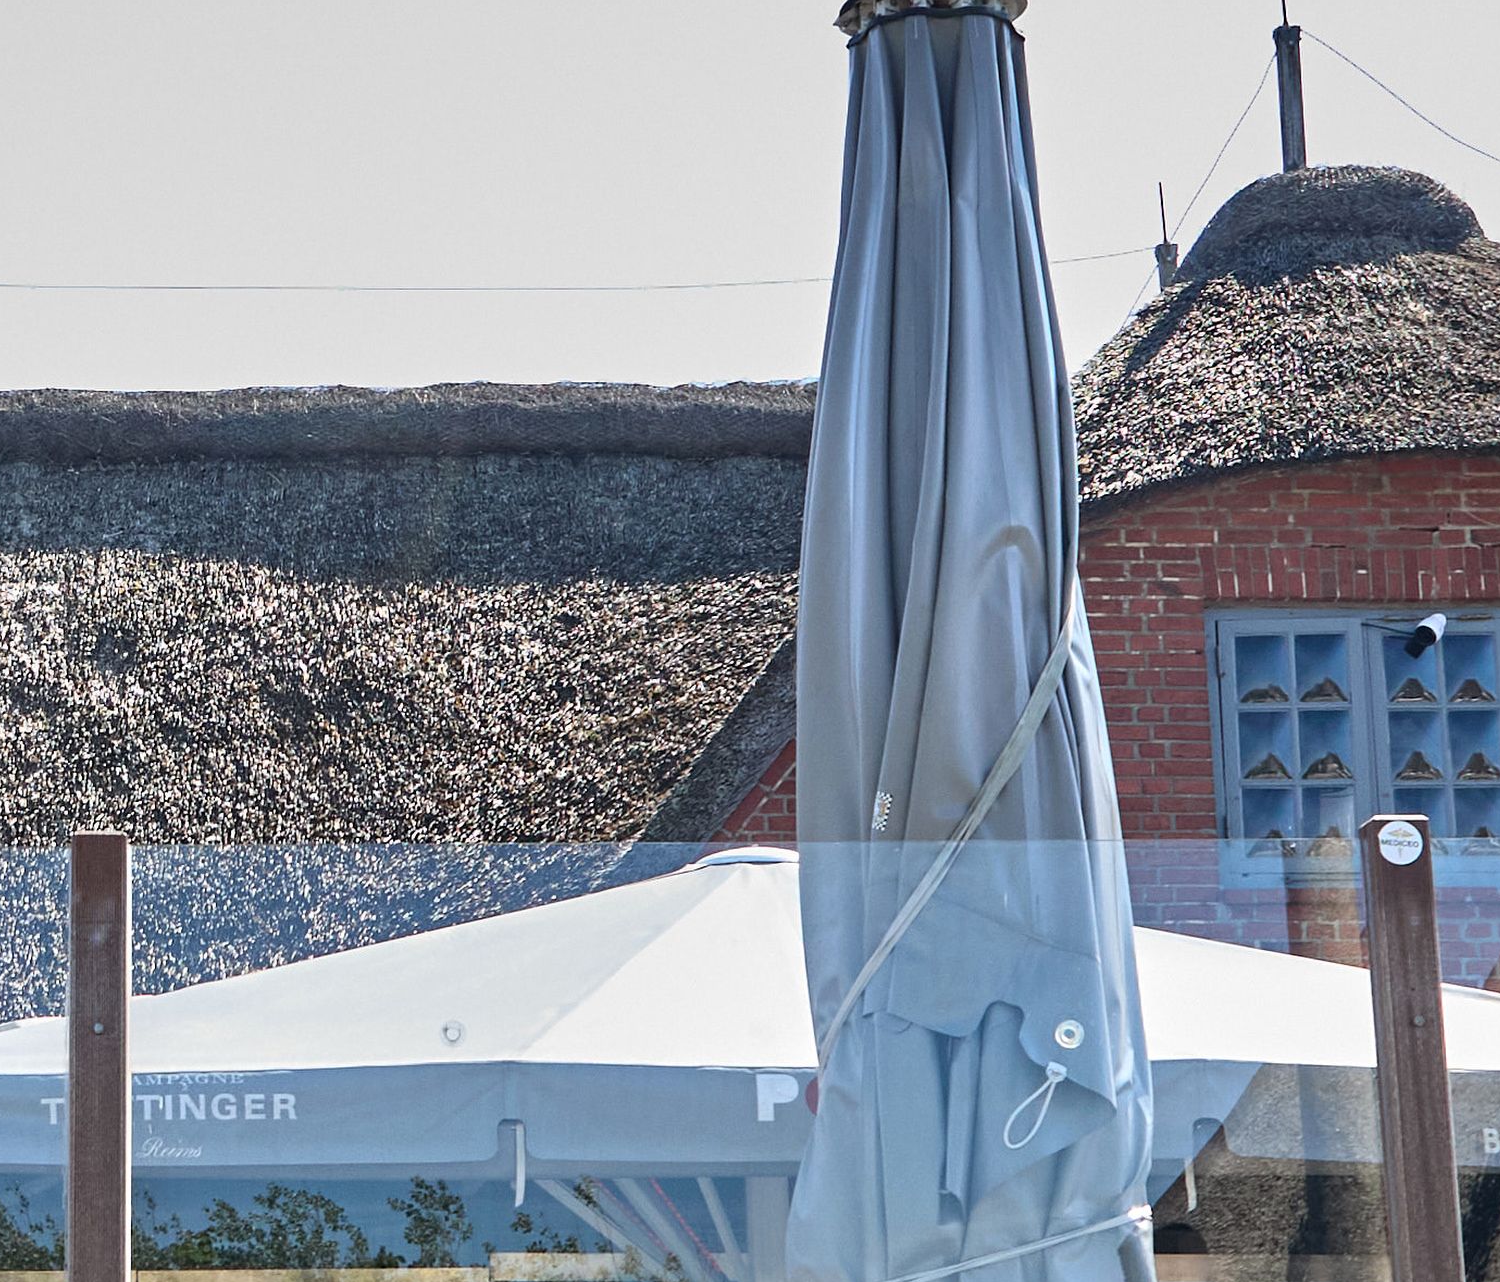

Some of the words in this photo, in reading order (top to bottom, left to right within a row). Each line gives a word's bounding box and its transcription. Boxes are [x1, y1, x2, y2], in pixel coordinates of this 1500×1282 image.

[132, 1072, 245, 1087] AMPAGNE
[41, 1092, 298, 1125] TTINGER
[135, 1136, 203, 1159] Reims
